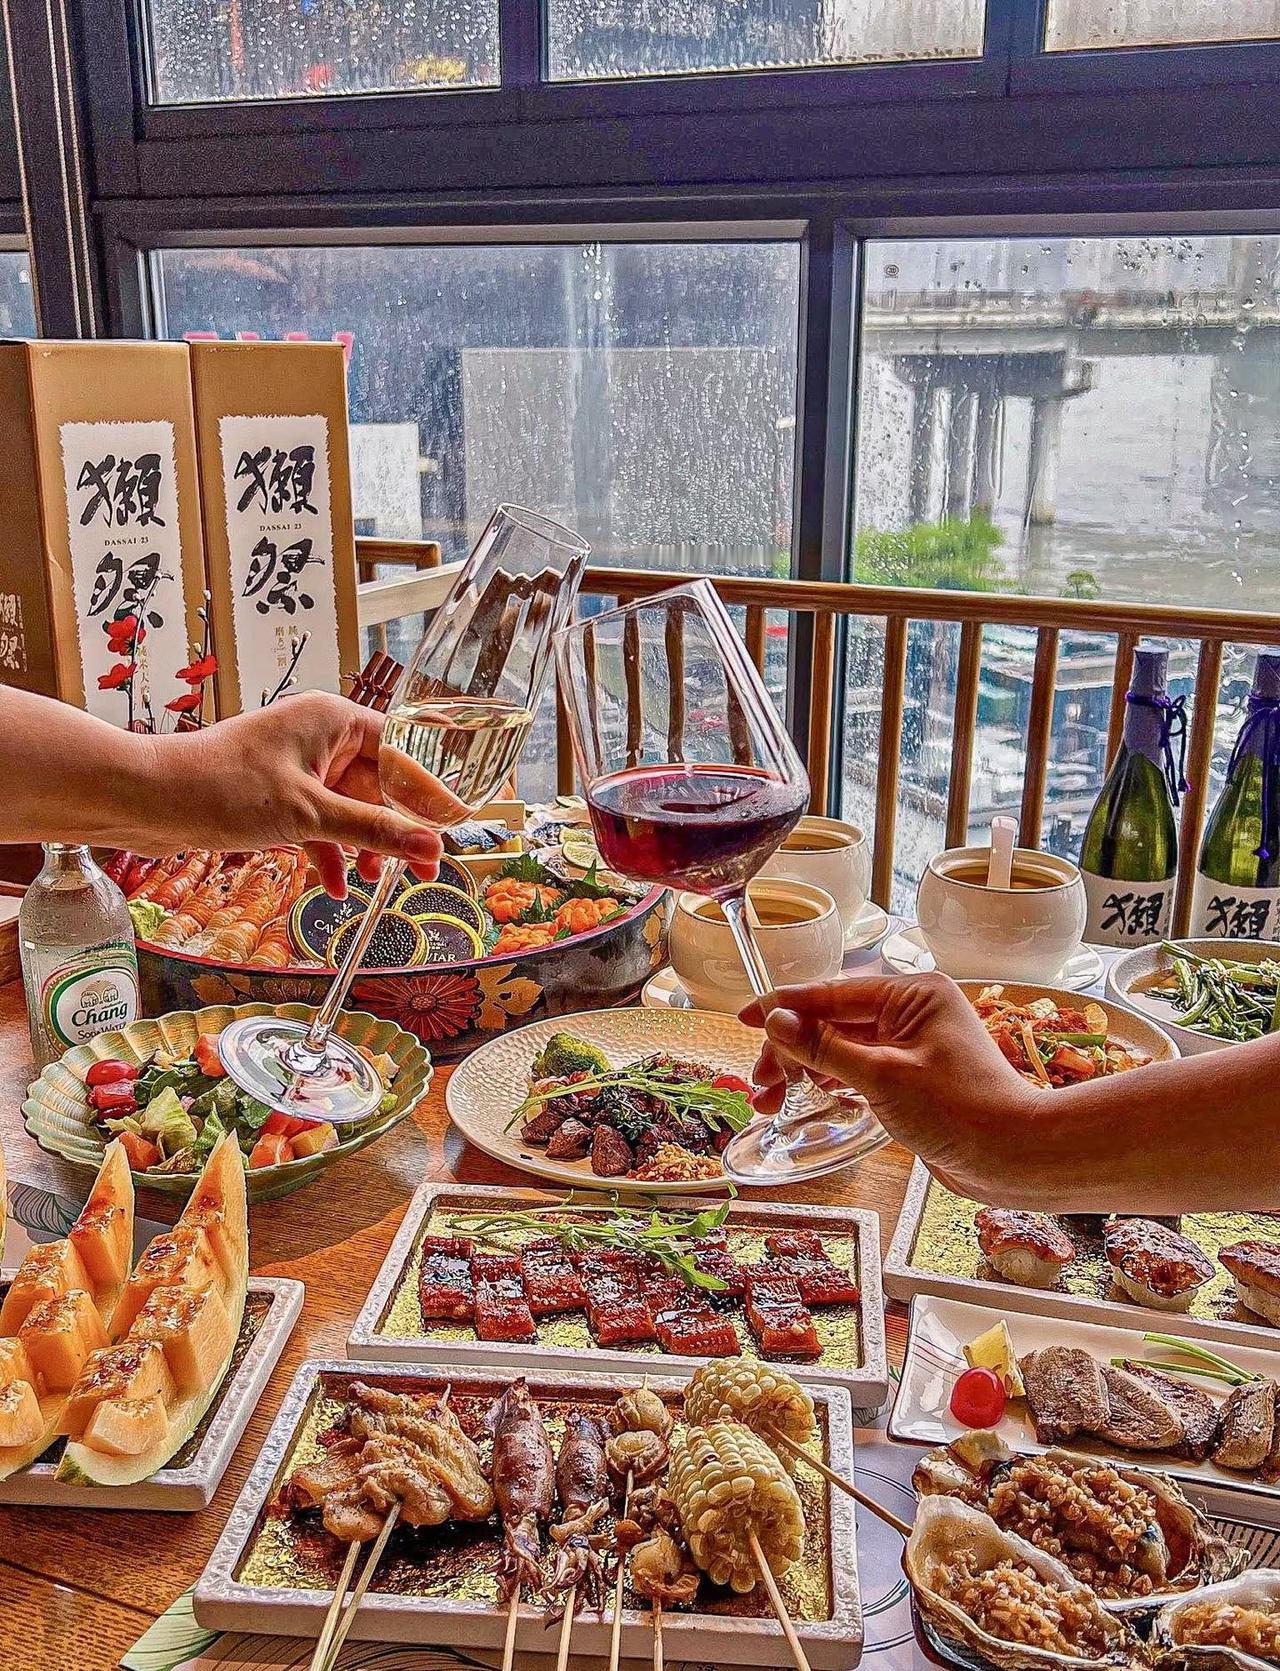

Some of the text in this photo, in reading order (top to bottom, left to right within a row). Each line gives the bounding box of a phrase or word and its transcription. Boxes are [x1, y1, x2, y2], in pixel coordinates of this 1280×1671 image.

[259, 523, 290, 531] DASSAI
[104, 537, 137, 546] DASSAI
[71, 1003, 128, 1027] Chang
